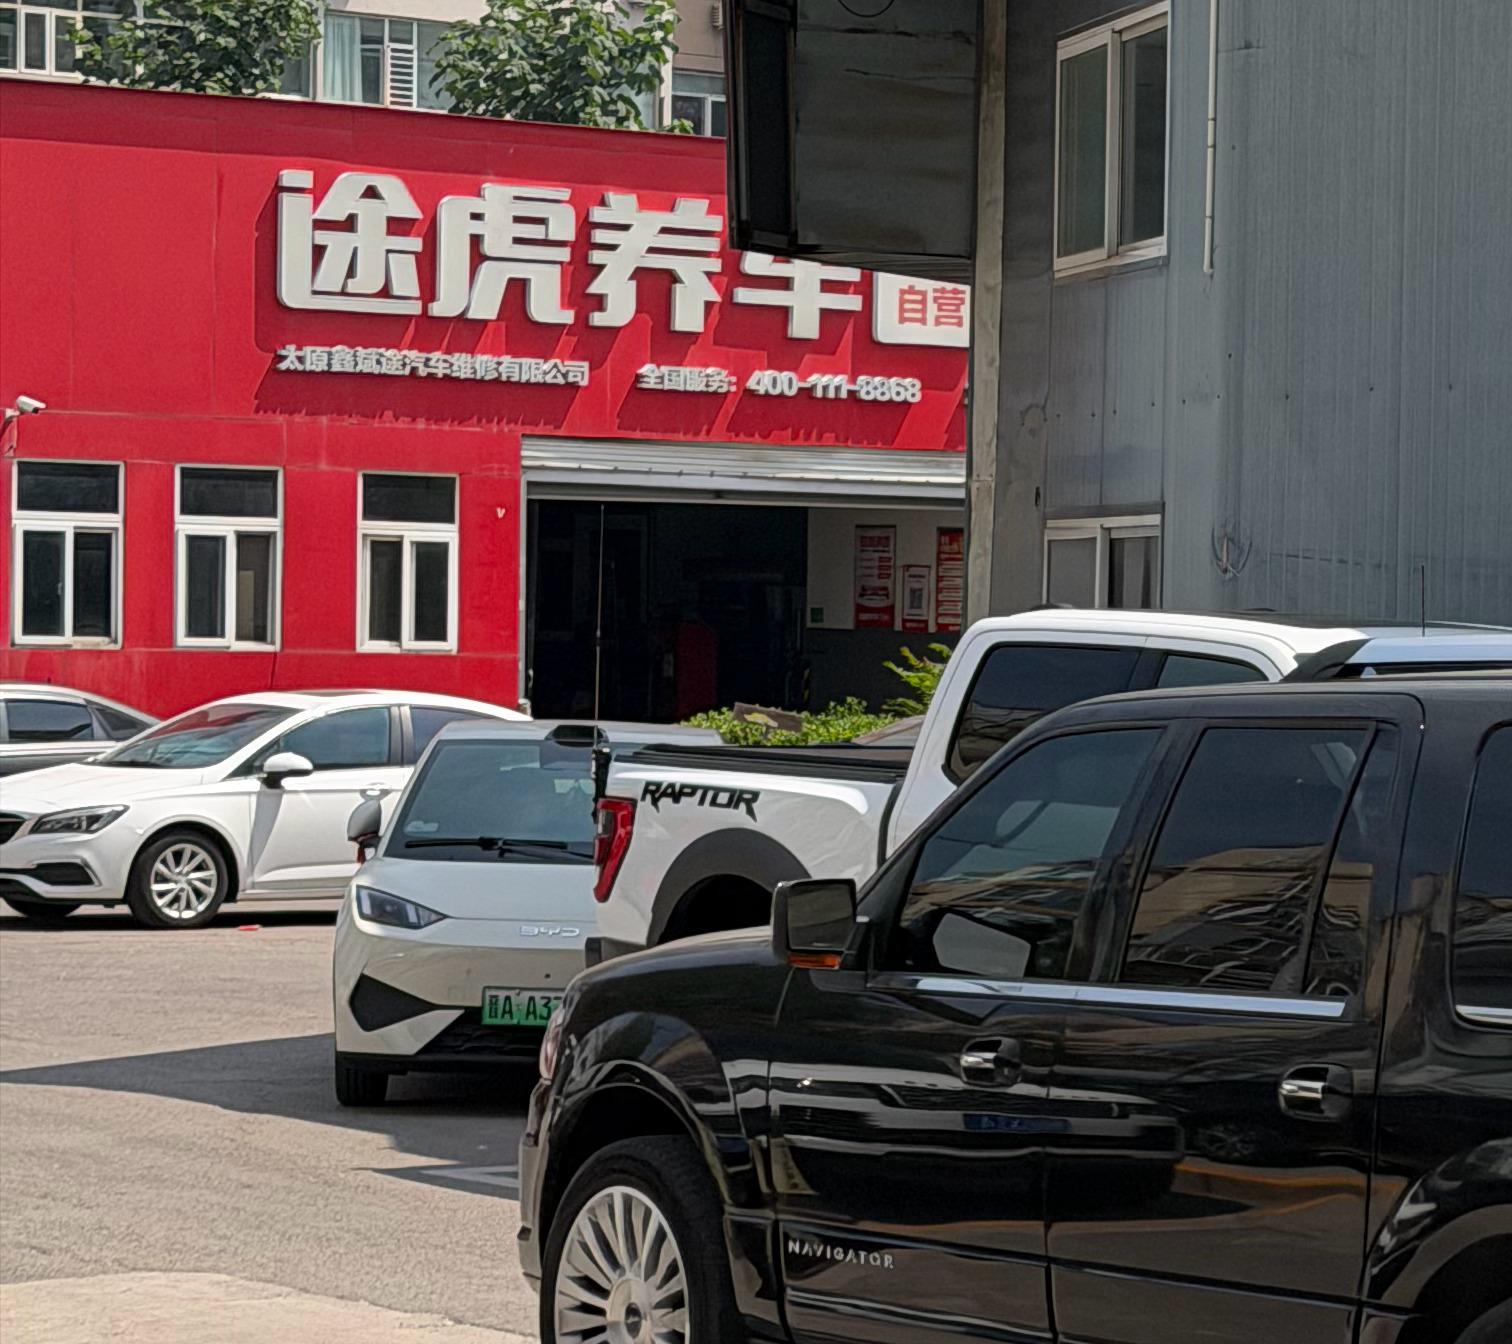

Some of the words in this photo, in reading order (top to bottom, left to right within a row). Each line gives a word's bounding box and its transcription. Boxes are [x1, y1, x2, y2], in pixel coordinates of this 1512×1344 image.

[276, 168, 863, 340] 途虎养车
[898, 285, 966, 328] 自营
[745, 369, 923, 403] 400-111-8868
[640, 780, 762, 822] RAPTOR
[520, 925, 580, 937] BYD
[788, 1239, 895, 1269] NAVIGATOR
